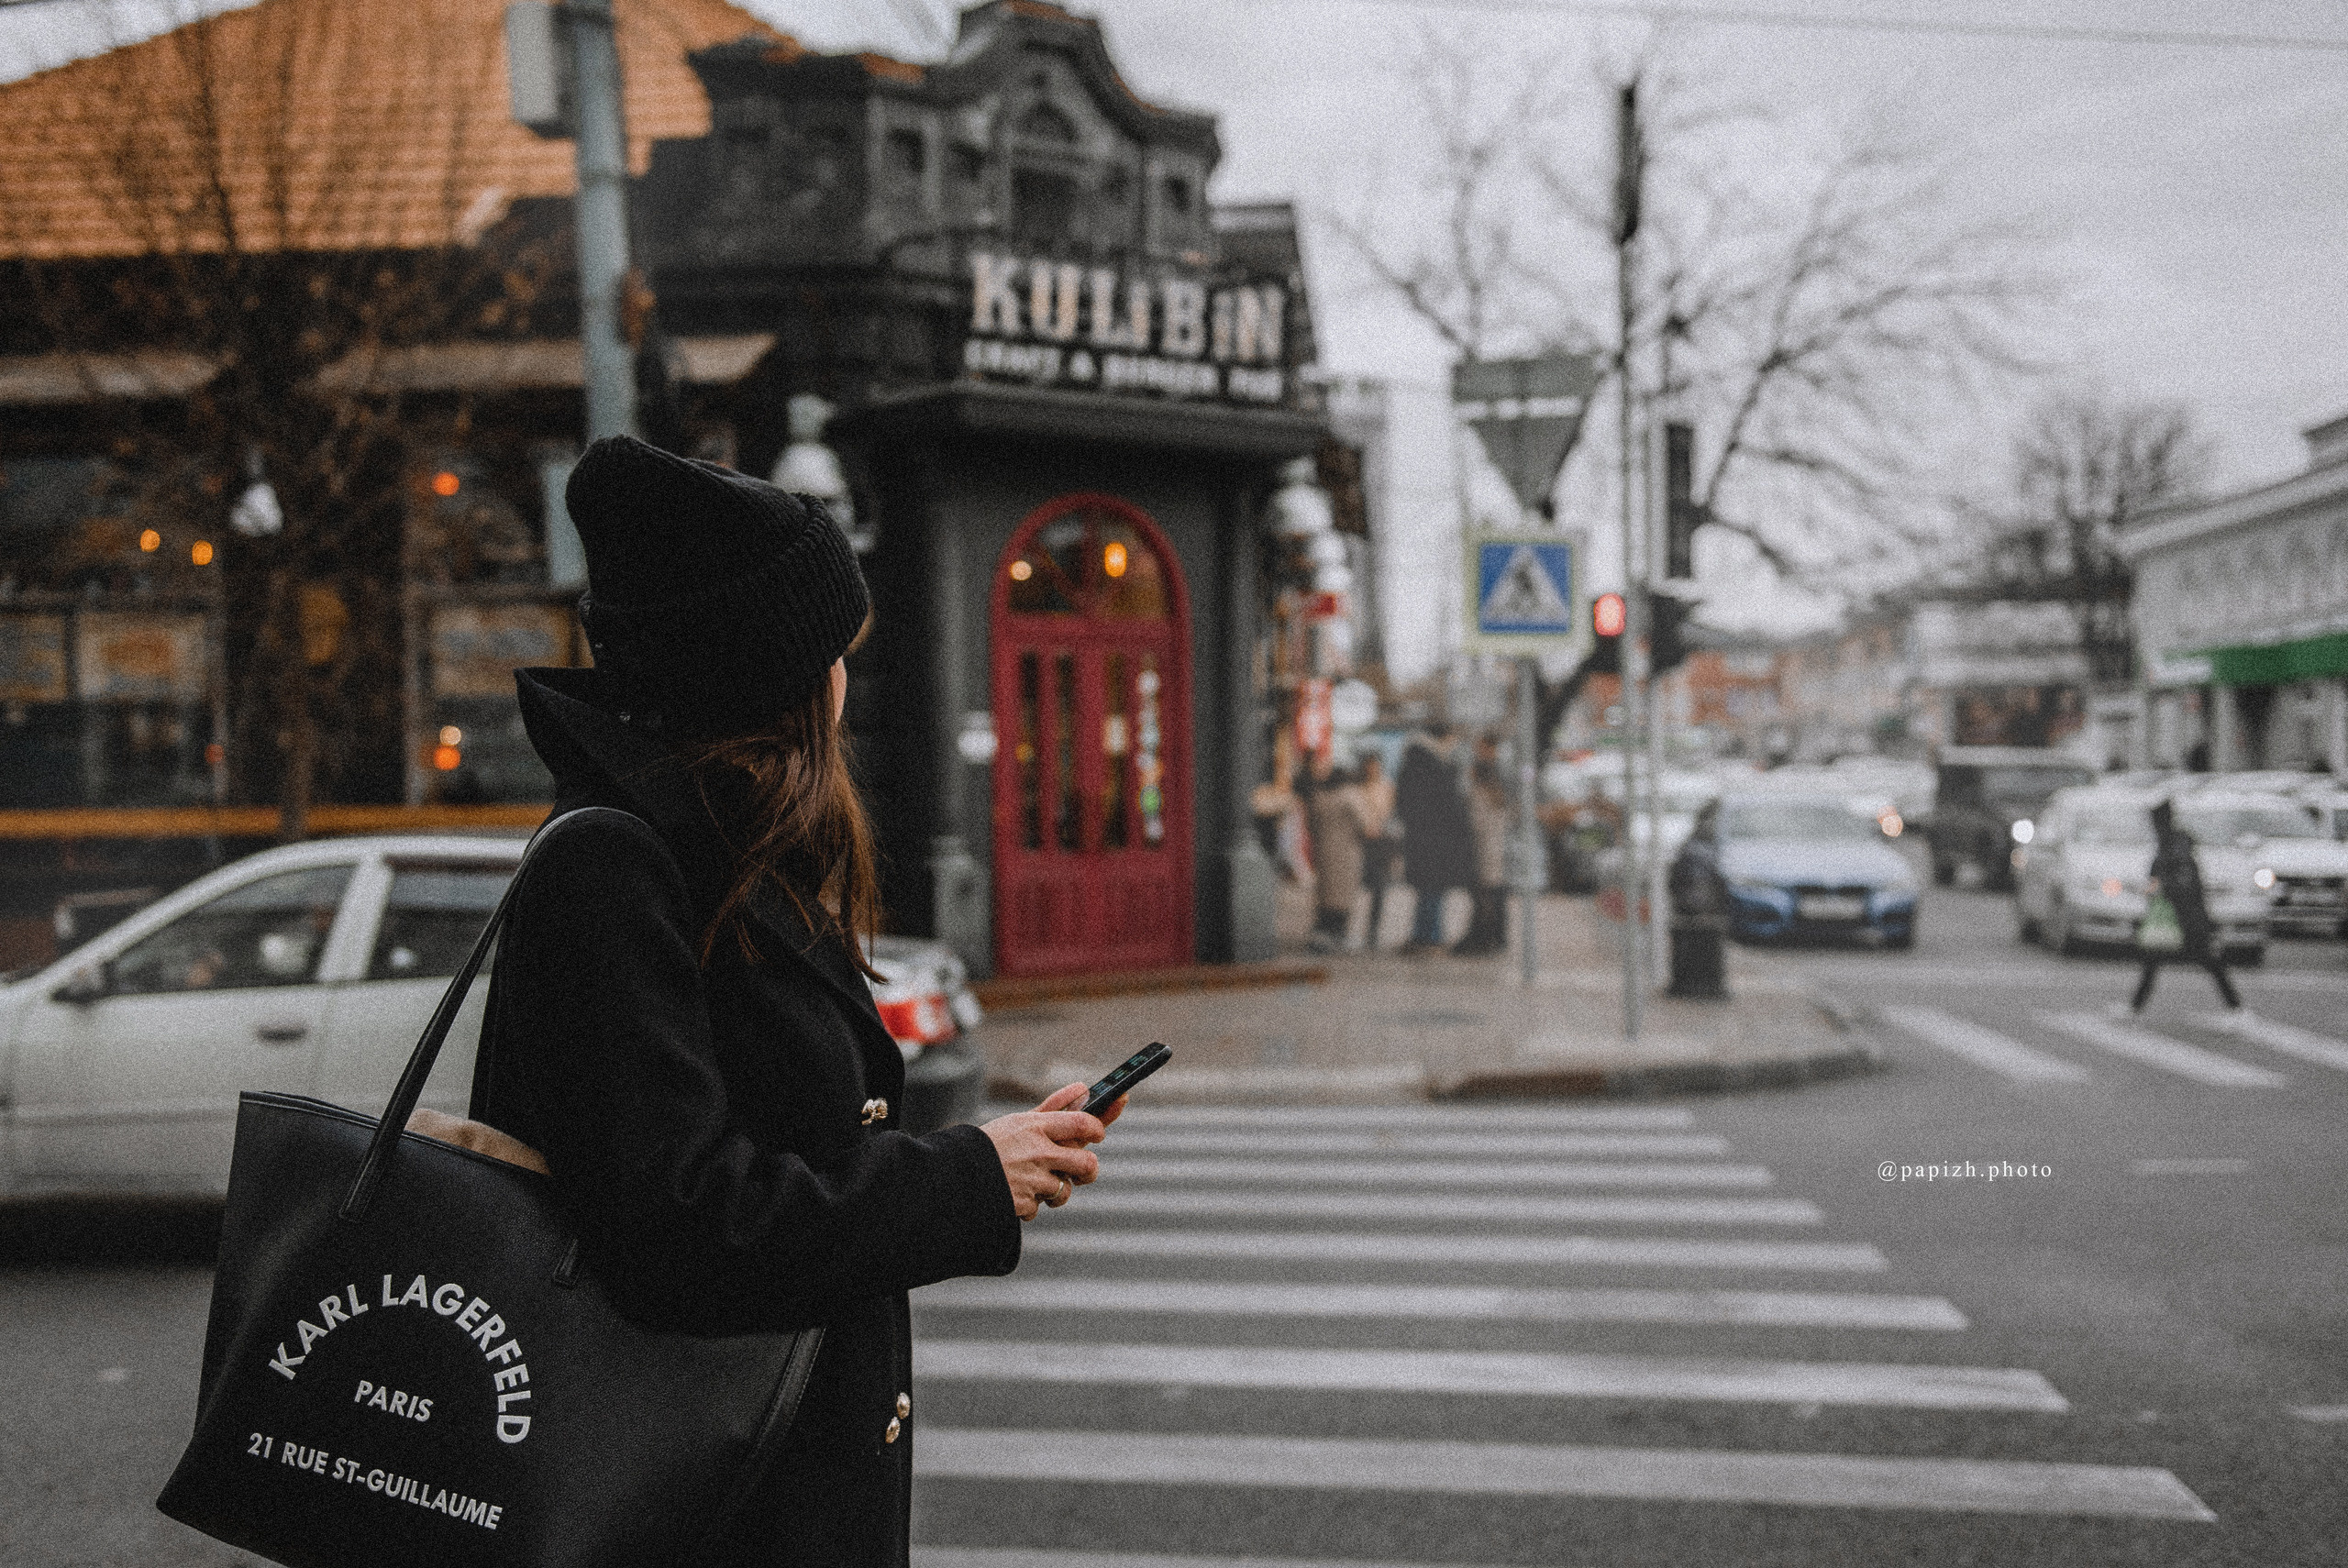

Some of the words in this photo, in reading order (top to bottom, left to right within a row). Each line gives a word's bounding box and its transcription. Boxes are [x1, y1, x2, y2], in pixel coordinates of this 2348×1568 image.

[268, 1284, 369, 1380] KARL
[382, 1274, 532, 1444] LAGERFELD
[354, 1380, 434, 1422] PARIS
[247, 1432, 274, 1459] 21
[281, 1441, 329, 1474] RUE
[332, 1457, 503, 1529] ST-GUILLAUME
